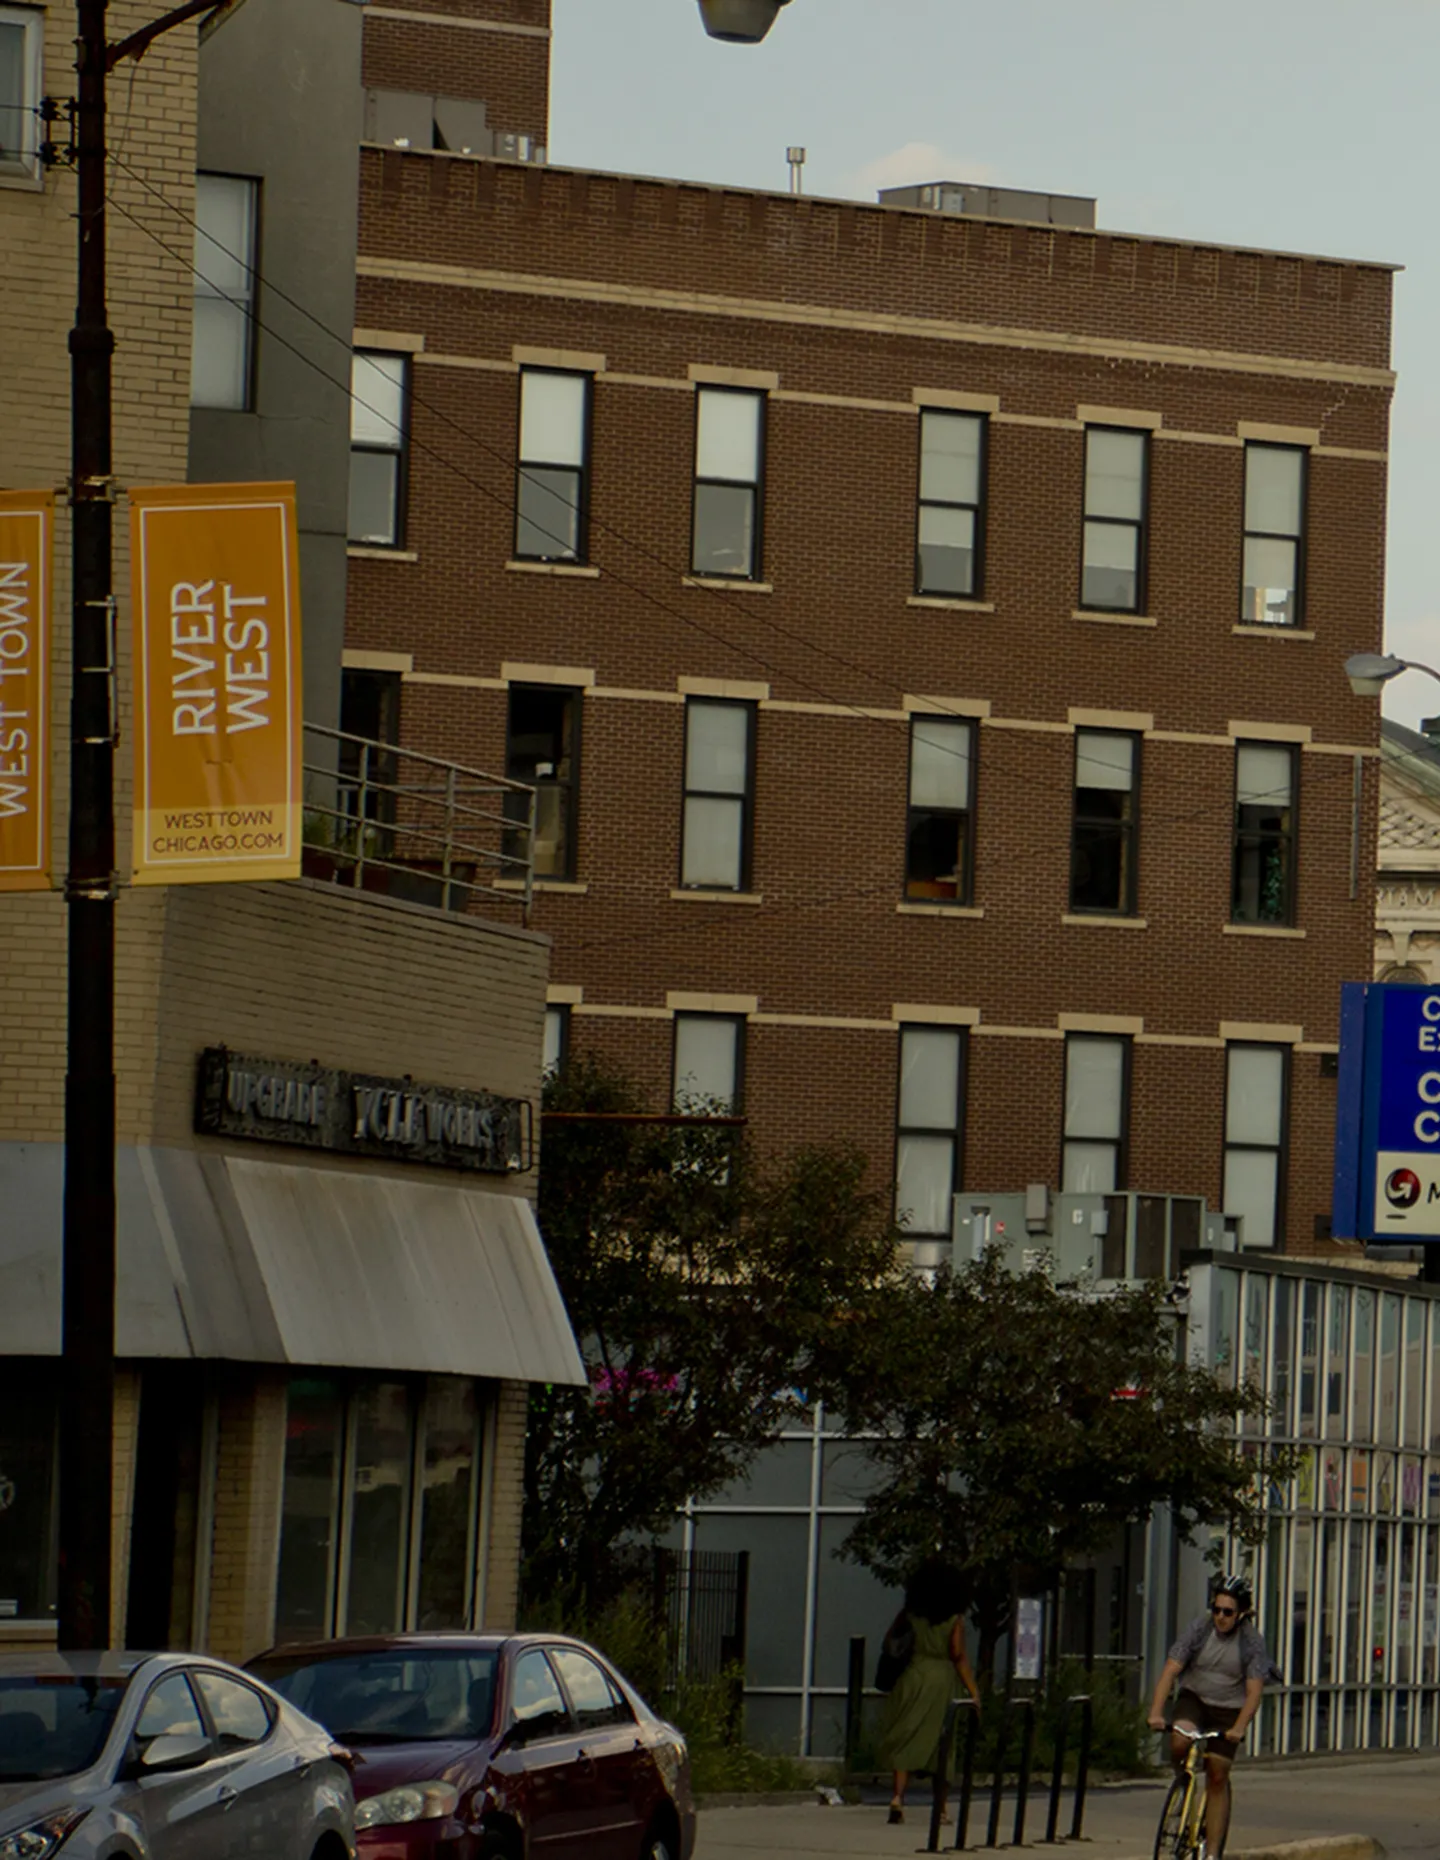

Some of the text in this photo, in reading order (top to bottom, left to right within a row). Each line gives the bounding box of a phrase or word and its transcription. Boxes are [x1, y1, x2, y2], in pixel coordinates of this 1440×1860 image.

[170, 579, 216, 735] RIVER
[223, 584, 270, 734] WEST
[153, 833, 283, 853] CHICAGO.COM
